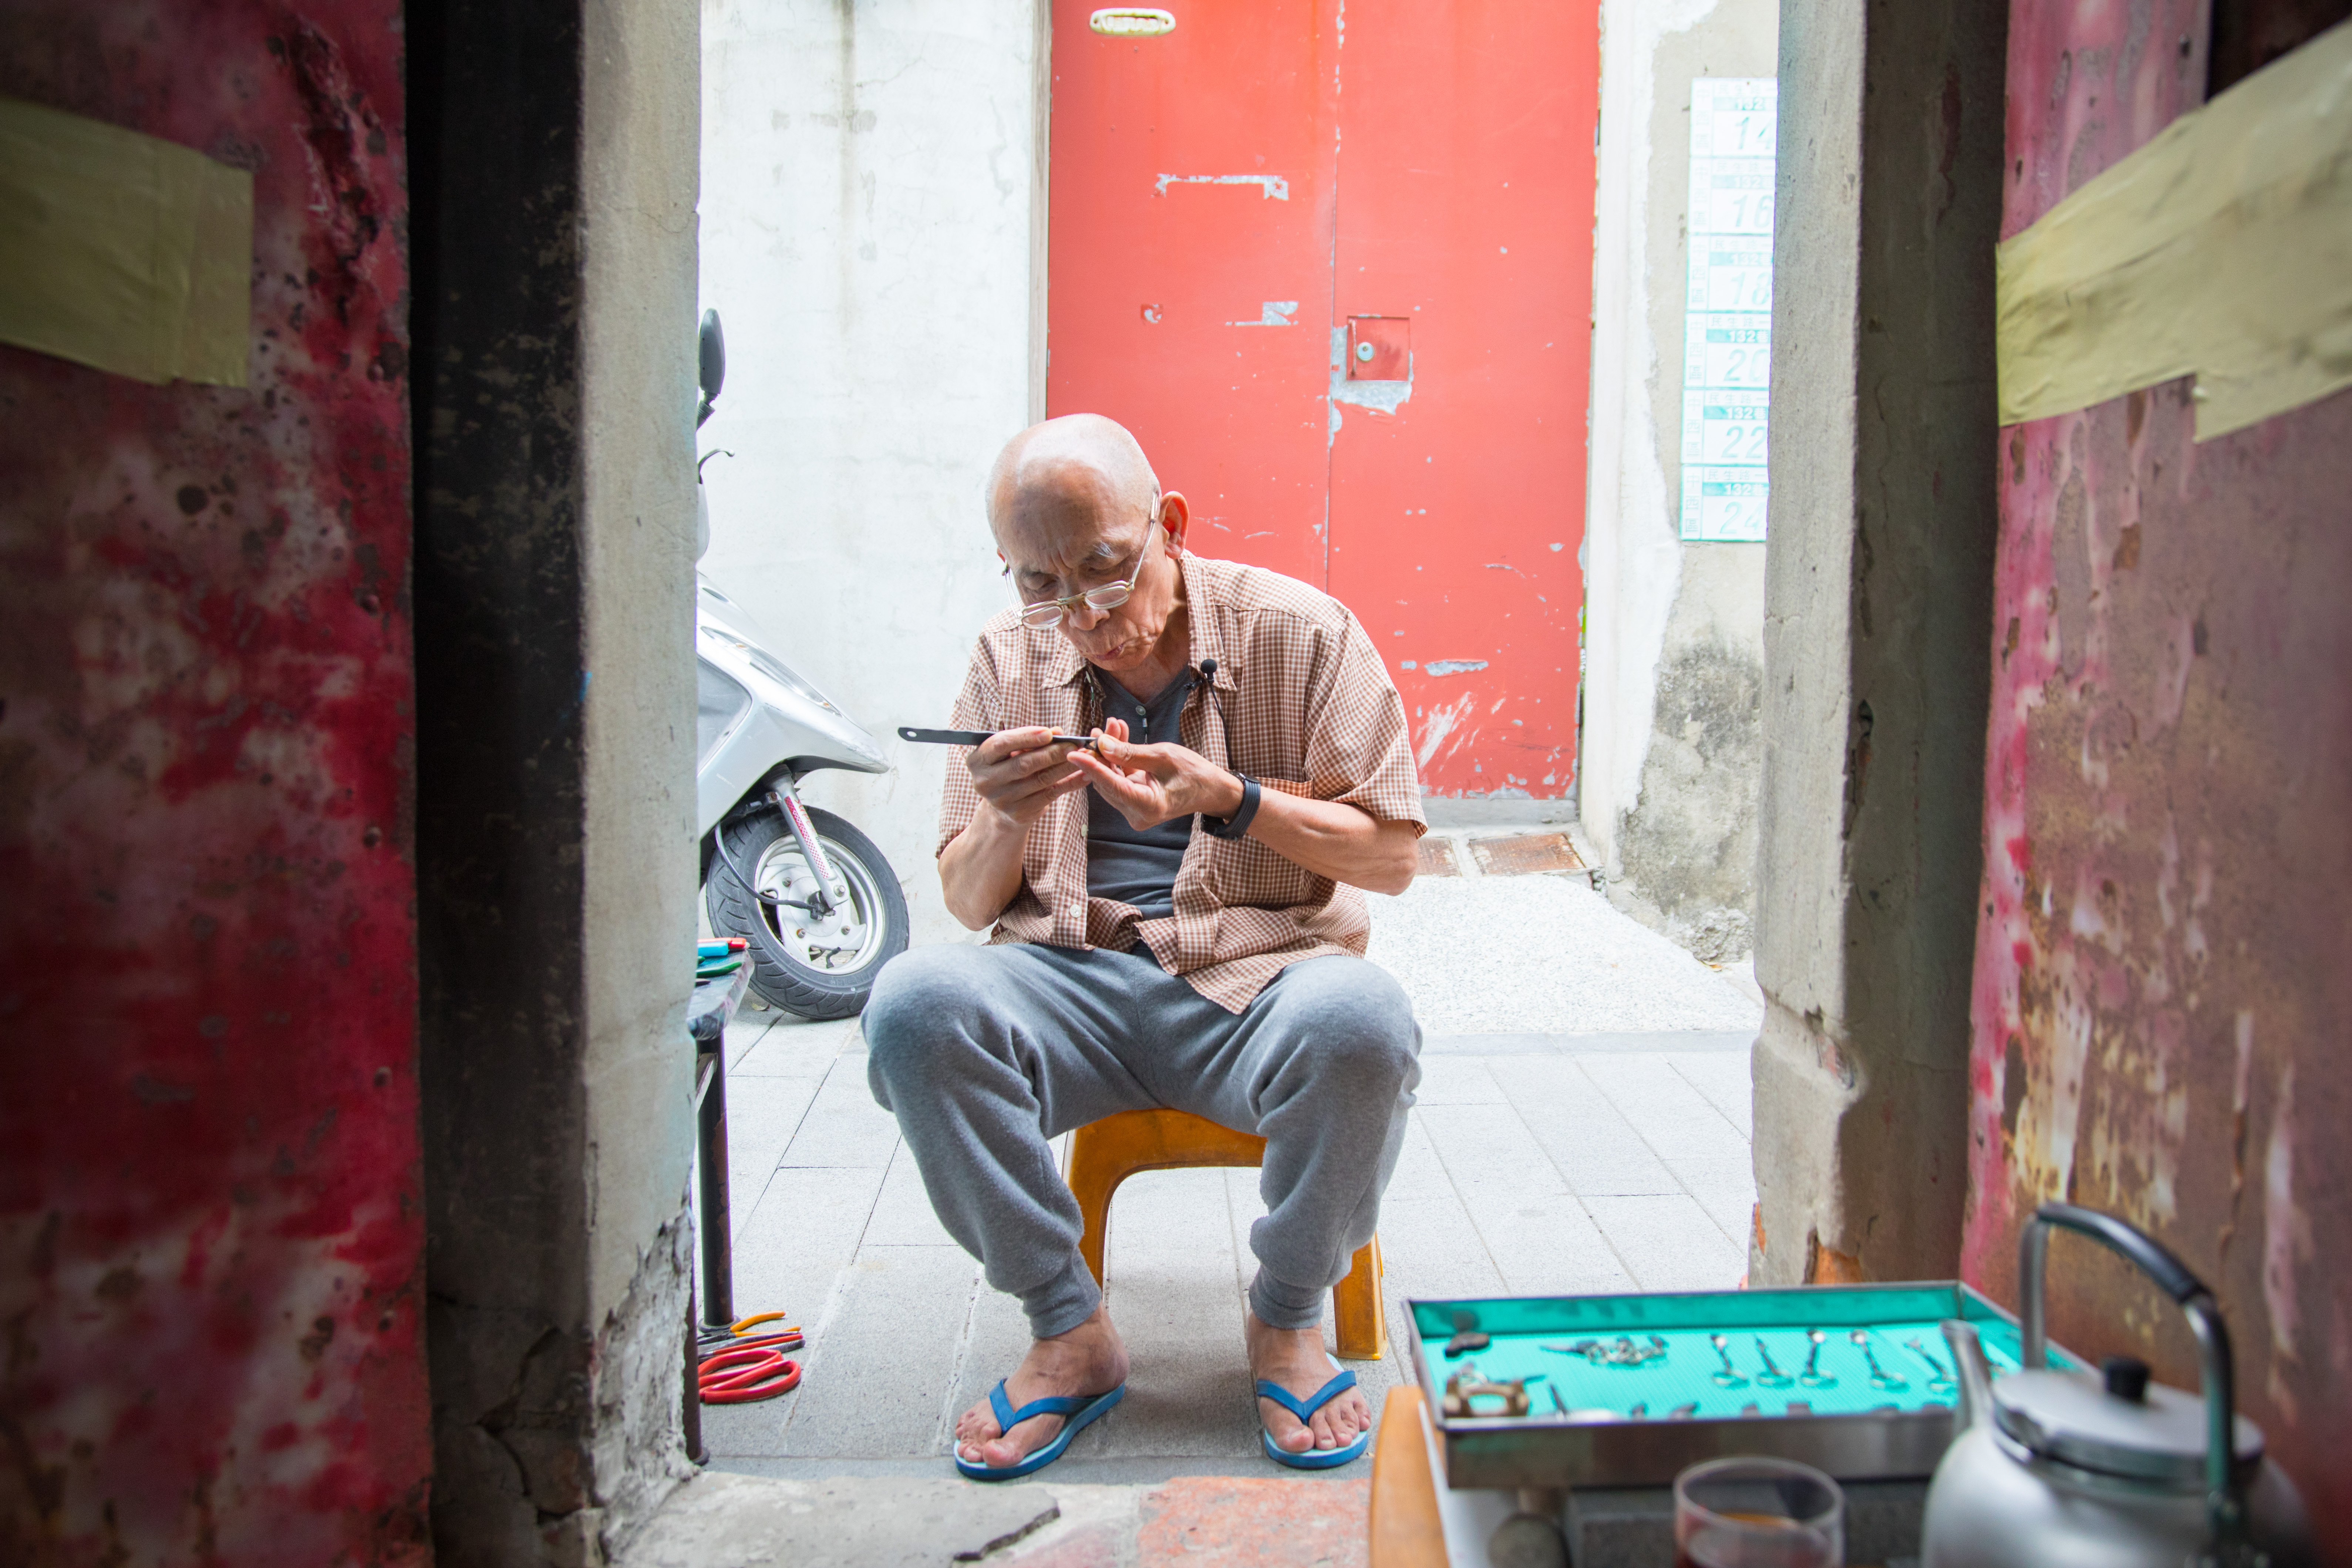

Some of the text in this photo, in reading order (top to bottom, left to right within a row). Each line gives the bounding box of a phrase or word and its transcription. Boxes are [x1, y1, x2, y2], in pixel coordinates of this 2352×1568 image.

[1735, 116, 1776, 149] 14
[1733, 193, 1774, 227] 16
[1731, 271, 1772, 305] 18
[1711, 316, 1770, 327] 民生路一
[1730, 330, 1769, 343] 132巷
[1689, 320, 1704, 380] 中西區
[1723, 348, 1770, 382] 20
[1709, 392, 1768, 404] 民生路一
[1727, 407, 1766, 419] 132巷
[1687, 396, 1701, 456] 中西區
[1721, 425, 1767, 458] 22
[1707, 469, 1767, 480] 民生路一
[1725, 484, 1765, 496] 132巷
[1685, 473, 1700, 533] 中西區
[1719, 500, 1766, 534] 24
[815, 837, 834, 869] DISK BRAKE
